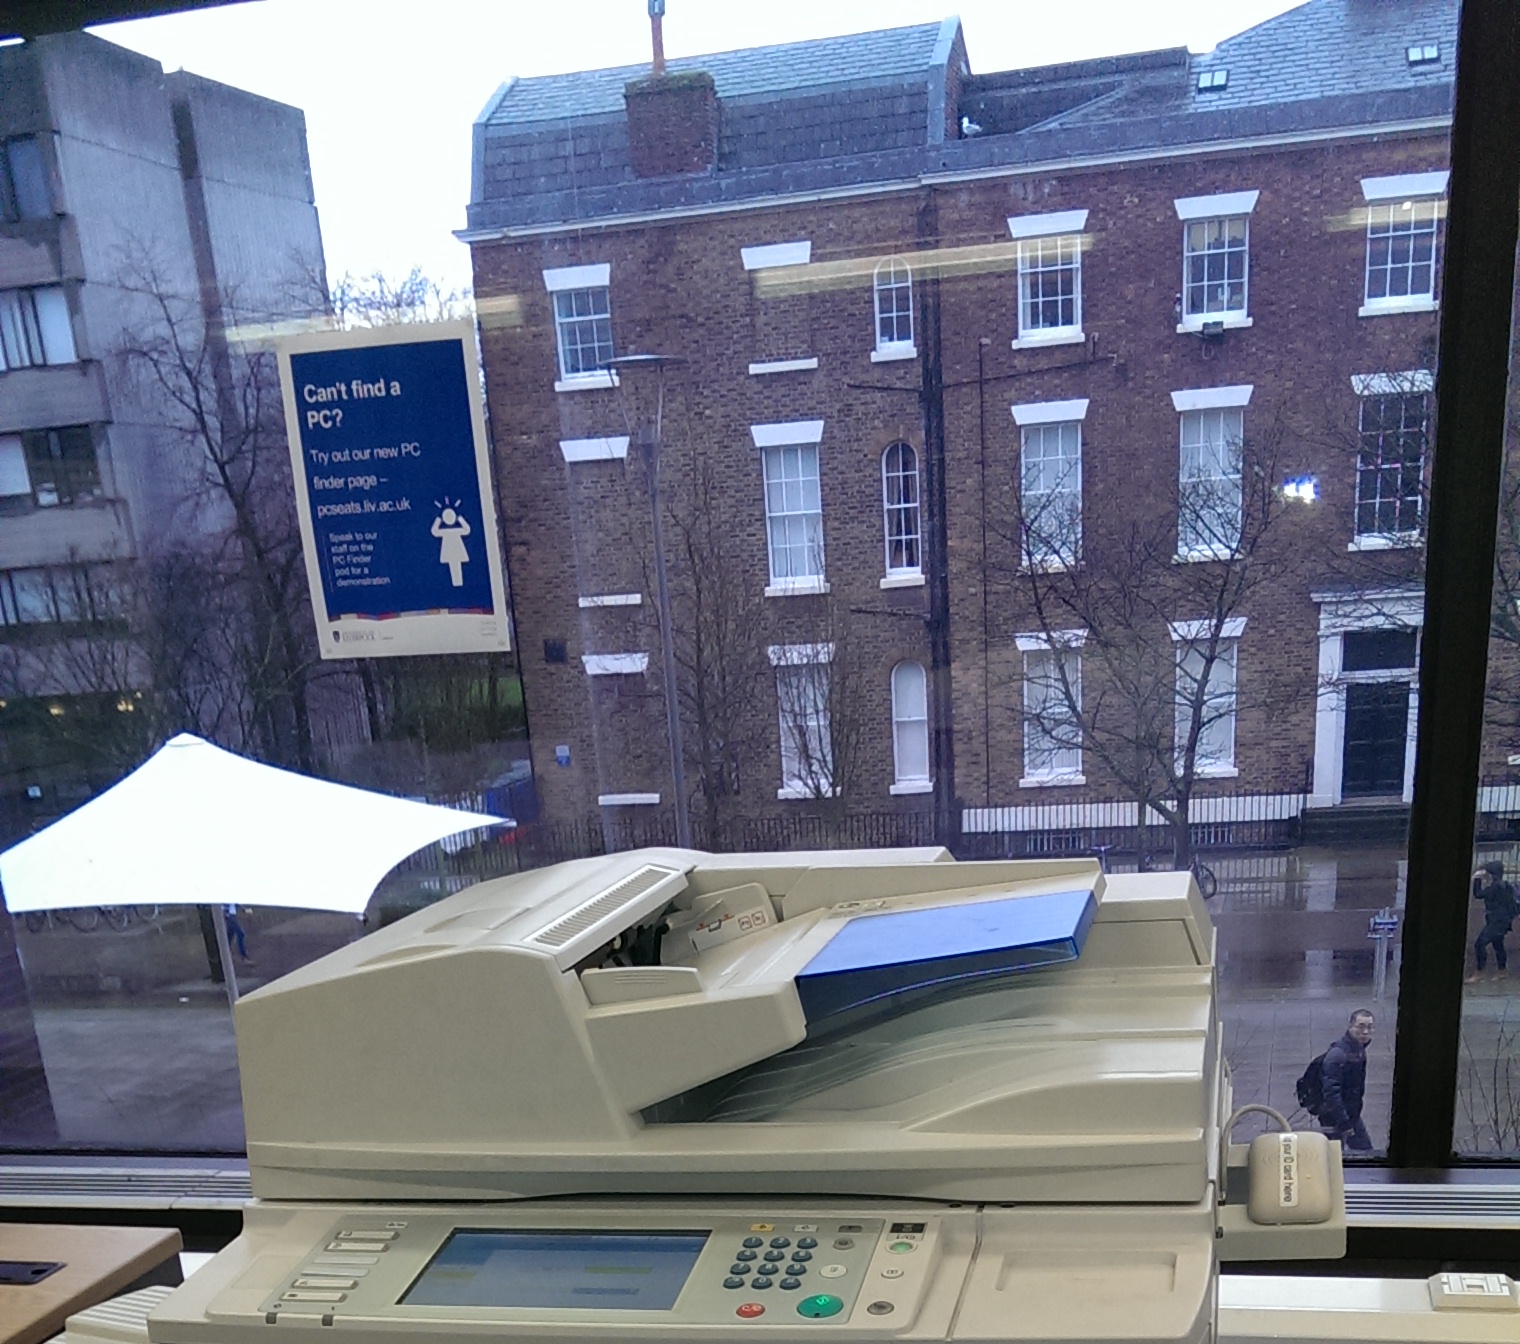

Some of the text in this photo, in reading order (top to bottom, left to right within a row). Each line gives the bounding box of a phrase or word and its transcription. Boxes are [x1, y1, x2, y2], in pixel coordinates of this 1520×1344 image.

[304, 378, 401, 403] Can't find a
[307, 408, 343, 429] PC?
[310, 442, 421, 466] Try out our new PC
[314, 475, 345, 490] finder
[347, 475, 377, 491] page
[317, 497, 412, 519] pcseats.liv.ac.uk
